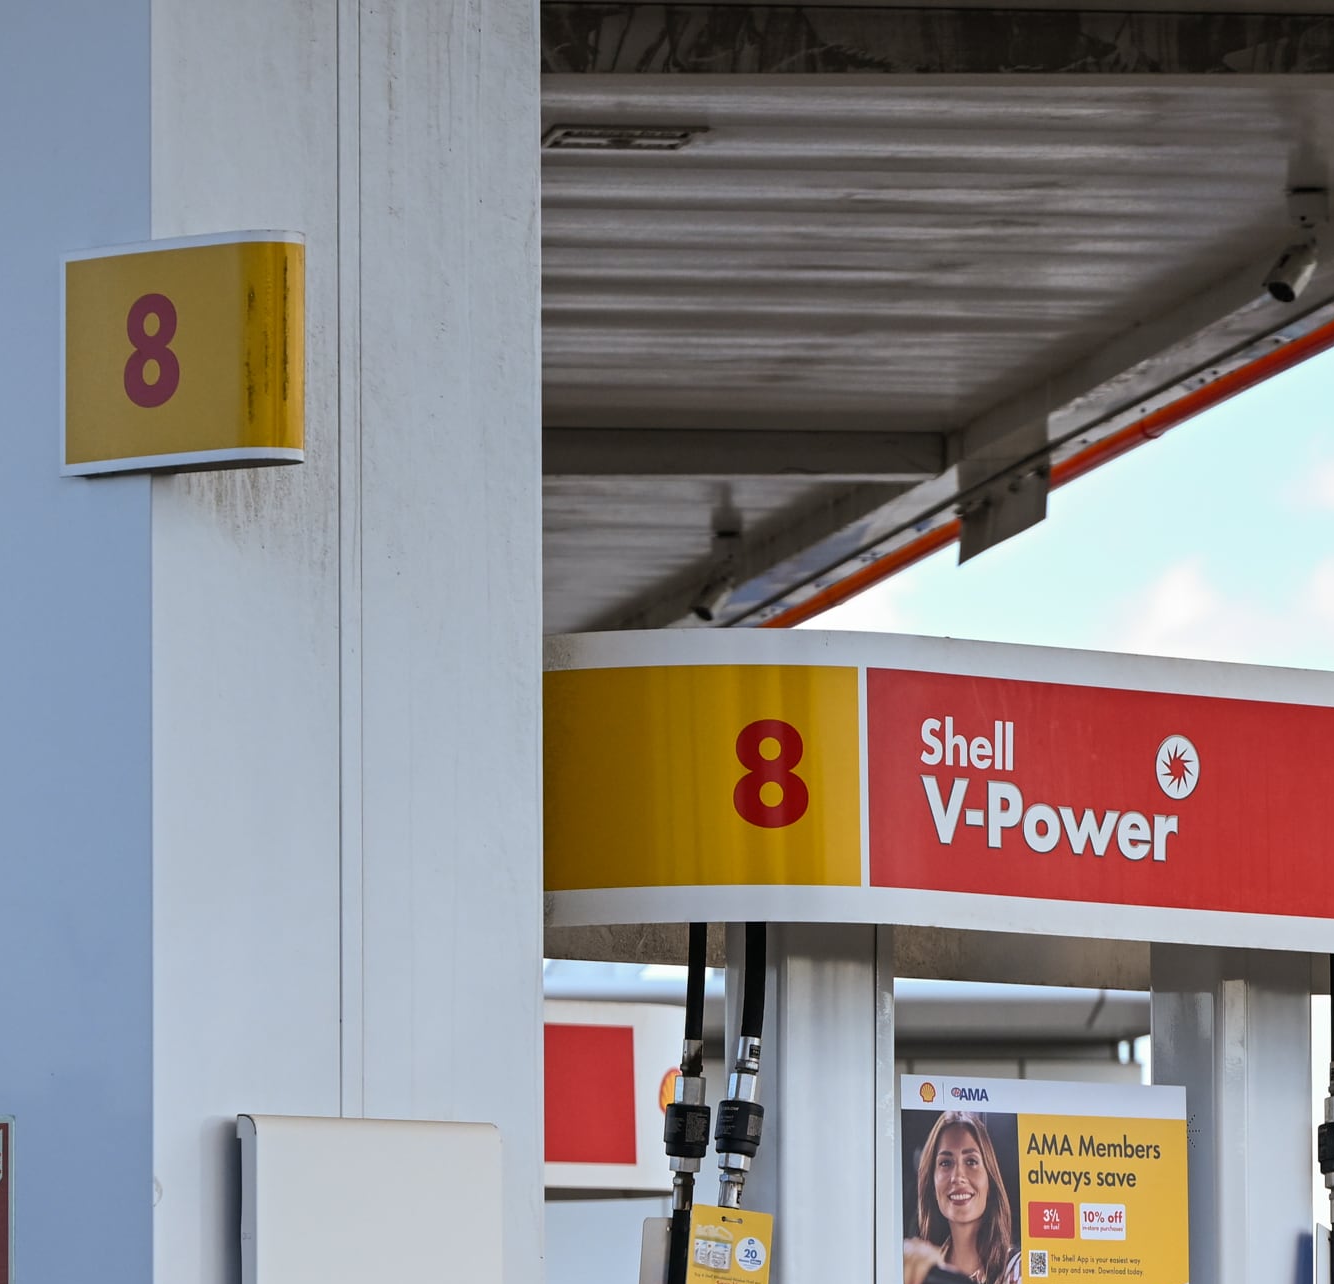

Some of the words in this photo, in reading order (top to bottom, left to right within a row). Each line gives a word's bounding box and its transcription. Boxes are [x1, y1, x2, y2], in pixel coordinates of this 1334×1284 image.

[123, 293, 180, 408] 8
[920, 717, 1014, 771] Shell
[733, 719, 809, 828] 8
[920, 775, 1179, 862] V-Power
[959, 1088, 989, 1102] AMA
[1027, 1133, 1073, 1157] AMA
[1079, 1135, 1161, 1160] Members
[1028, 1162, 1091, 1192] always
[1096, 1172, 1137, 1187] save
[1083, 1211, 1105, 1223] 10%
[1108, 1211, 1123, 1223] off
[744, 1248, 758, 1259] 20
[1051, 1254, 1061, 1262] The
[1062, 1254, 1076, 1263] Shell
[1078, 1255, 1089, 1265] App
[1096, 1258, 1108, 1266] your
[1110, 1256, 1128, 1264] easiest
[1130, 1258, 1141, 1266] way
[1058, 1267, 1069, 1276] pay
[1070, 1266, 1081, 1274] and
[1098, 1266, 1126, 1275] Download
